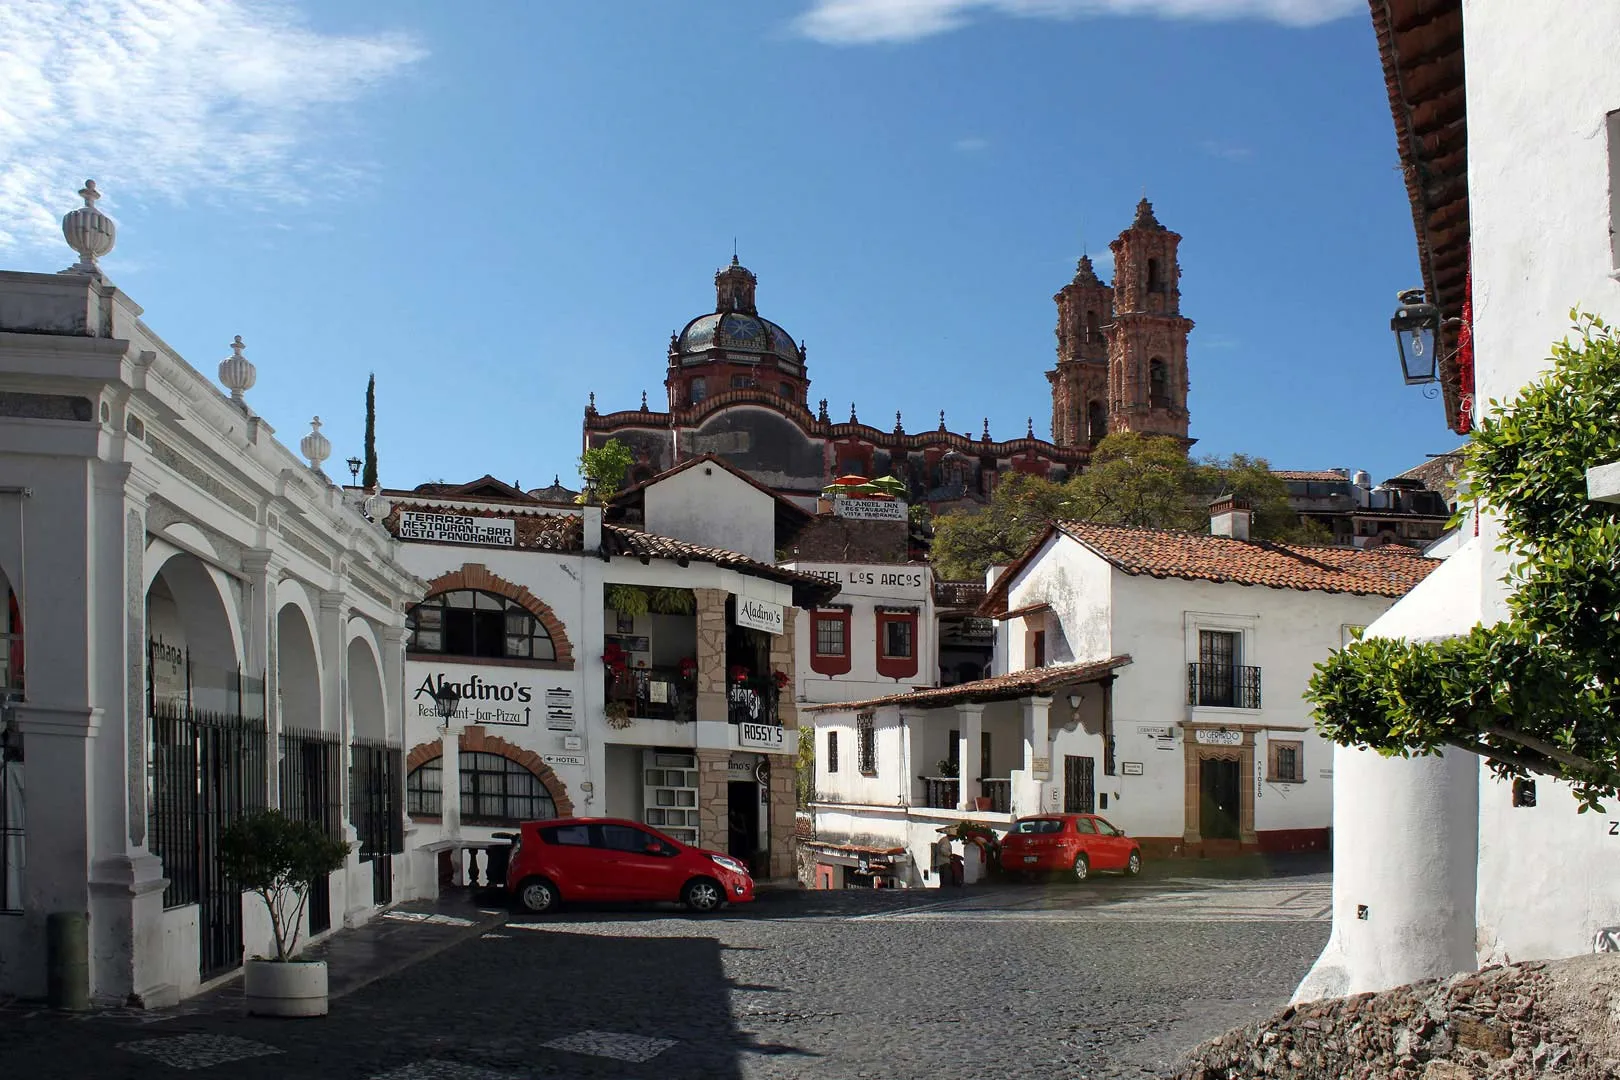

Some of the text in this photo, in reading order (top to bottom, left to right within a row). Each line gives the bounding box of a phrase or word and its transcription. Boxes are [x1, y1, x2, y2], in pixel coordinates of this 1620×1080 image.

[406, 512, 474, 526] TERRAZA
[401, 528, 513, 545] VISTA PANORAMICA
[403, 520, 511, 536] RESTAURANT-BAR
[741, 600, 781, 624] Aladino's
[414, 672, 533, 703] Aladino's
[418, 703, 520, 722] Restaant-bar-Pizza
[556, 756, 579, 764] HOTEL
